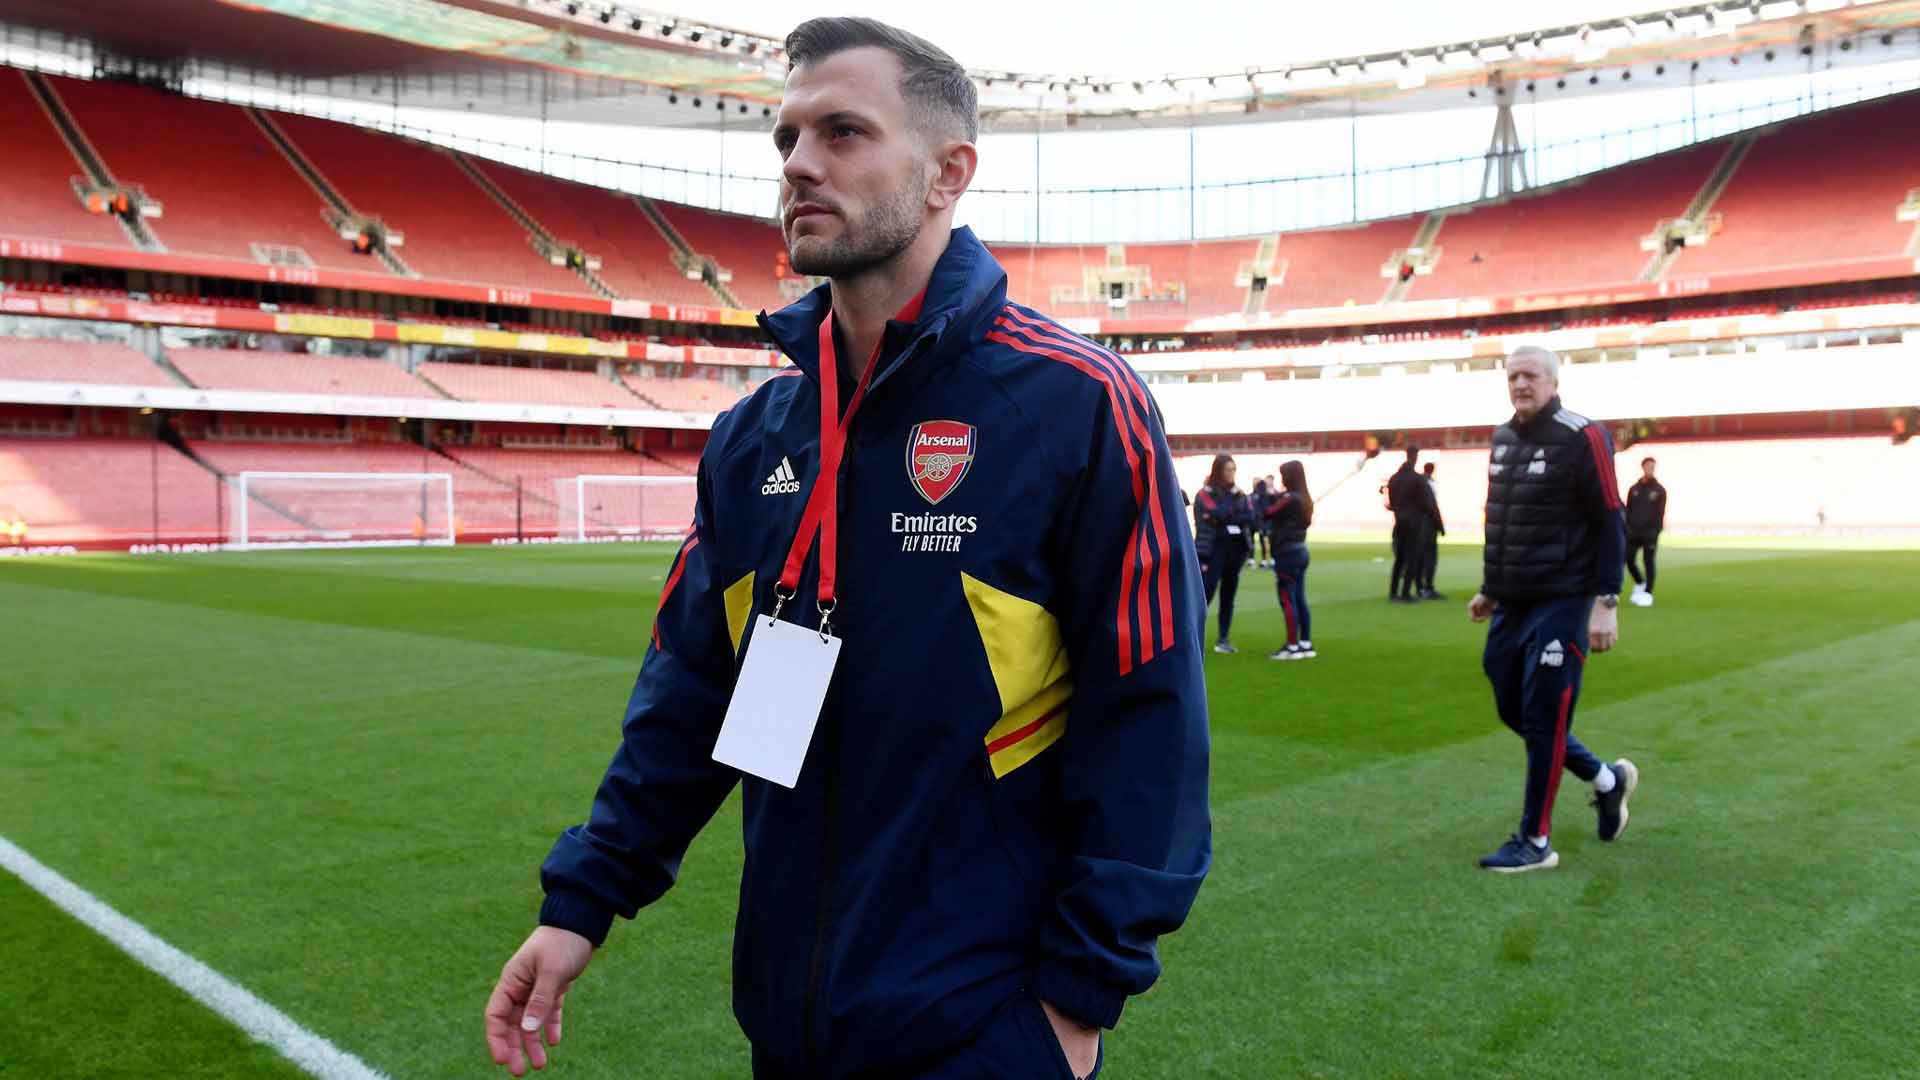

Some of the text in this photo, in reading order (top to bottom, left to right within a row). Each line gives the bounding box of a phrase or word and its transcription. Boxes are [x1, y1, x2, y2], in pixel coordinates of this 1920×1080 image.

[917, 433, 968, 446] Arsenal
[761, 479, 800, 495] adidas
[891, 511, 977, 533] Emirates
[902, 534, 962, 552] FLY BETTER
